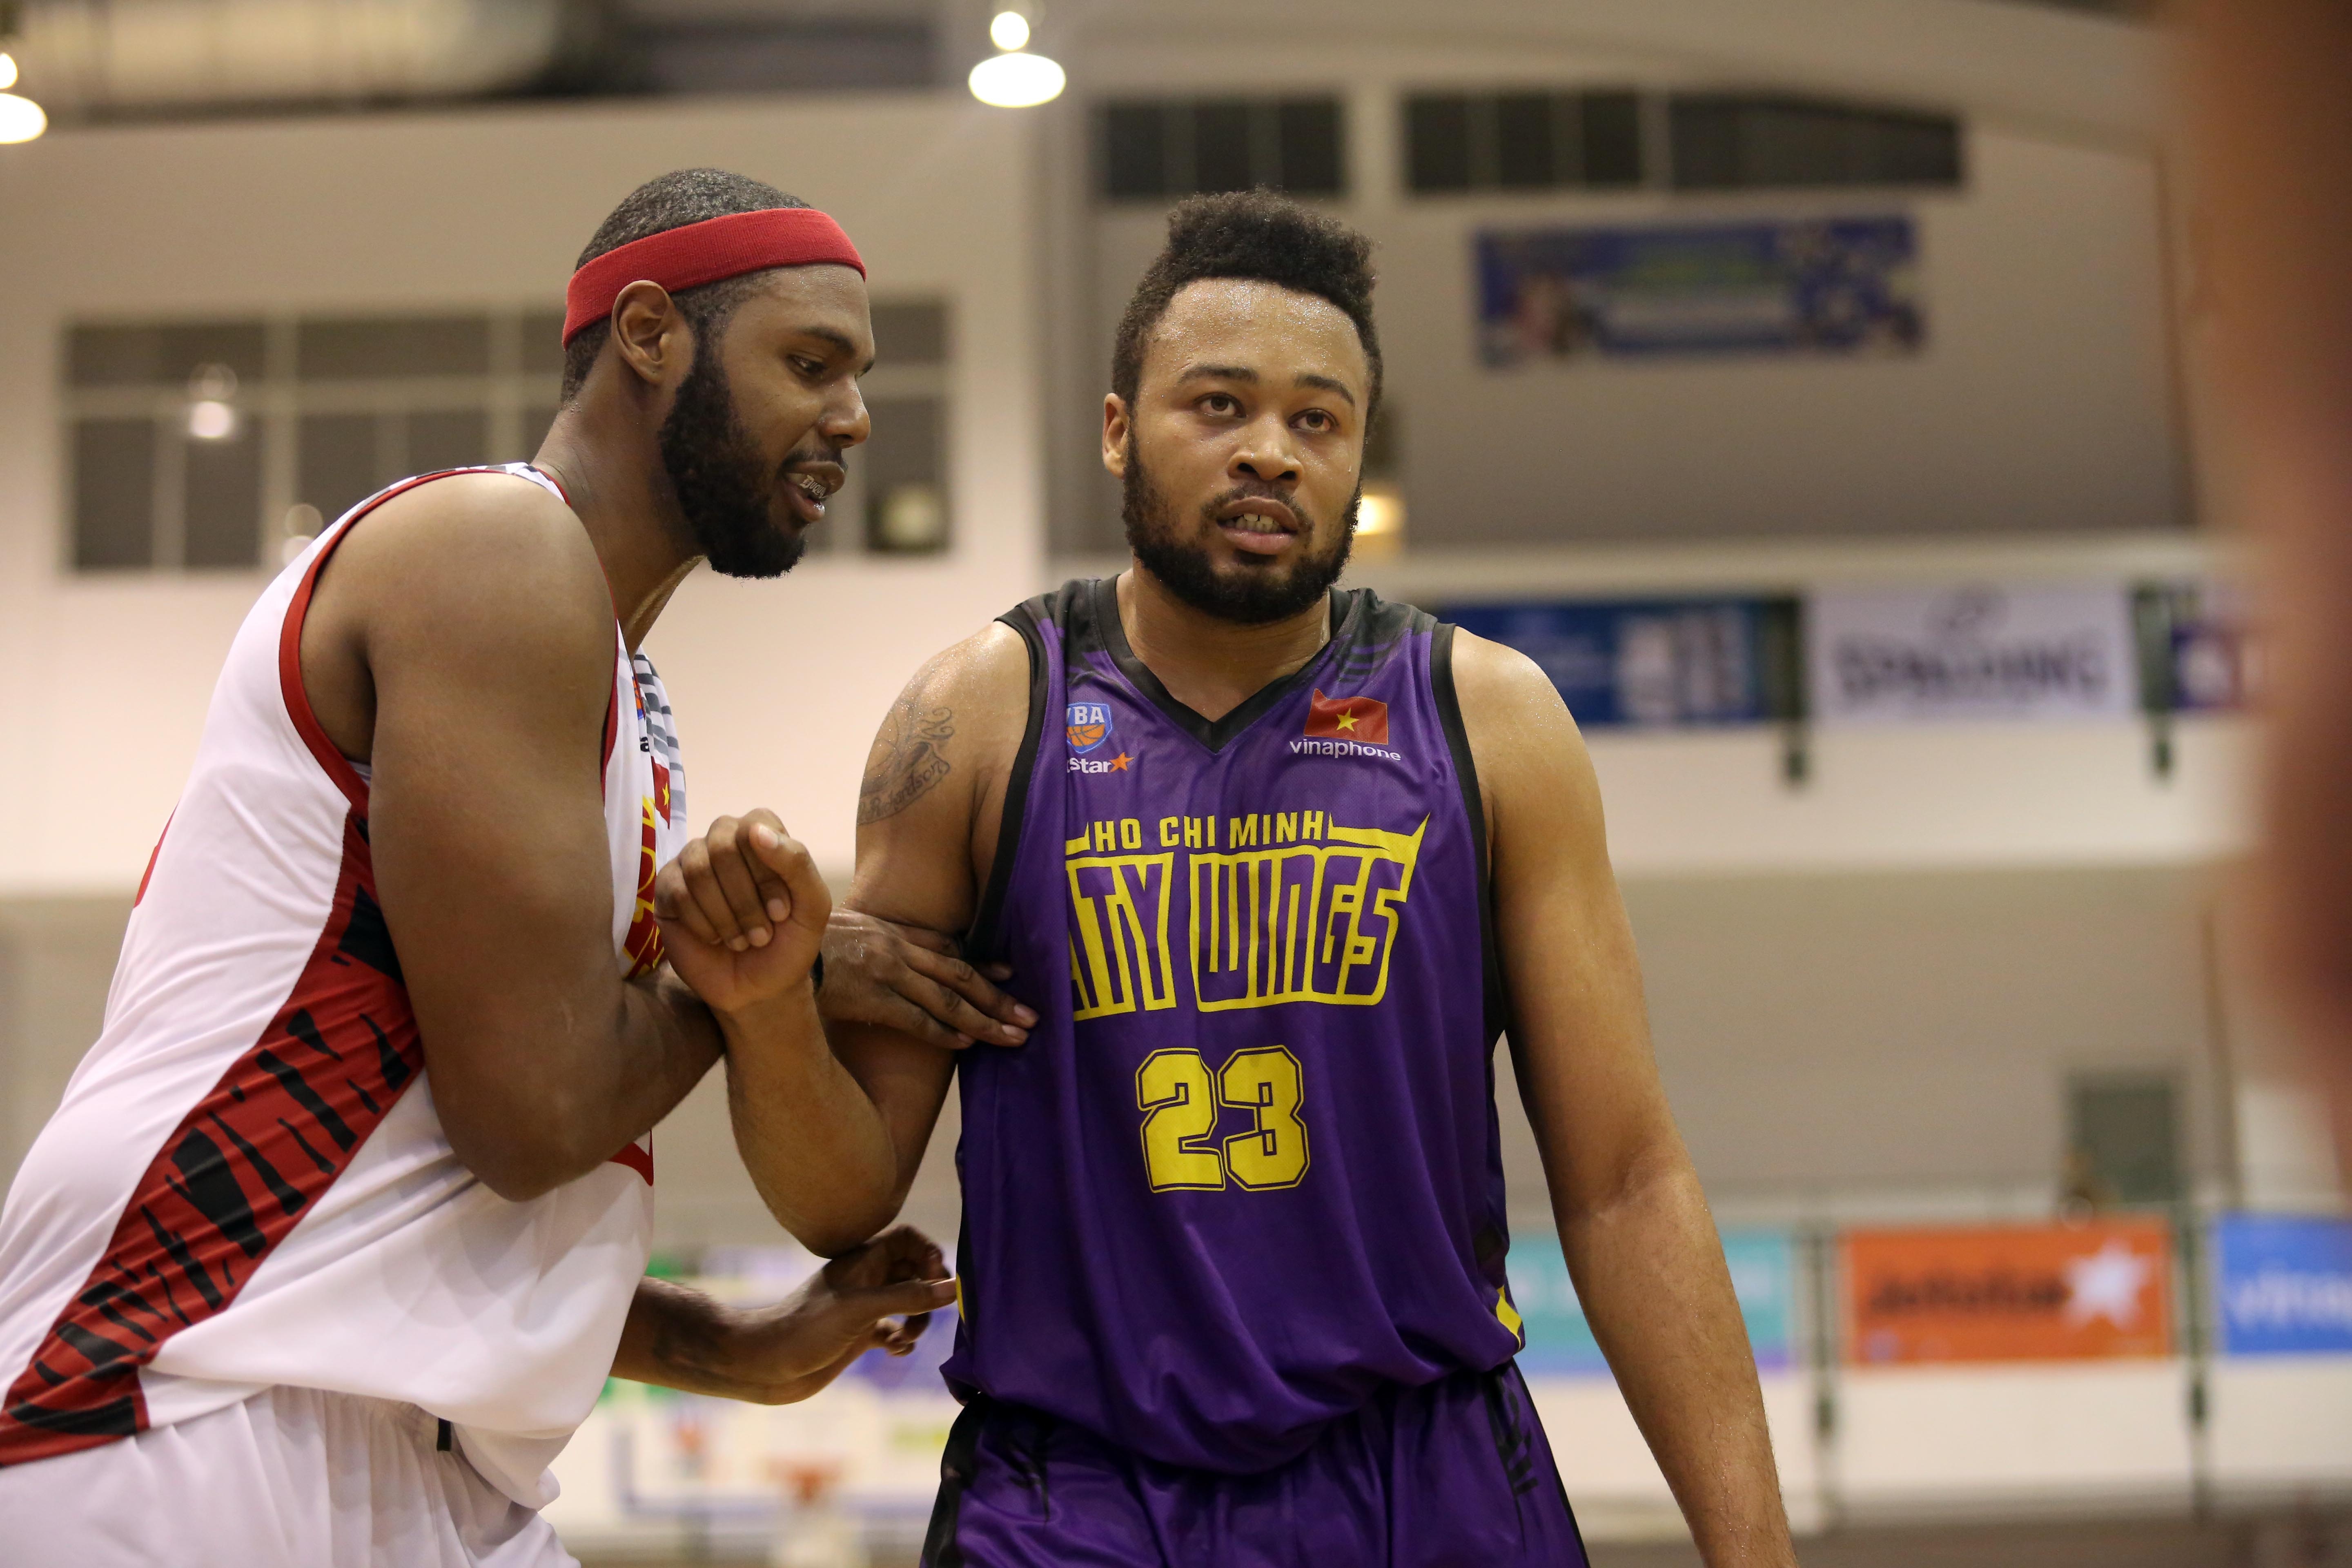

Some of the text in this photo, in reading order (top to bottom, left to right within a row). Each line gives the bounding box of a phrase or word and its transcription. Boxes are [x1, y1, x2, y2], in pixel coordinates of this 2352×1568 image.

[1067, 757, 1112, 774] star
[1289, 739, 1401, 761] vinaphone
[1094, 810, 1324, 852] HO CHI MINH
[1065, 844, 1414, 1021] ITY WINGS
[1135, 1044, 1310, 1193] 23
